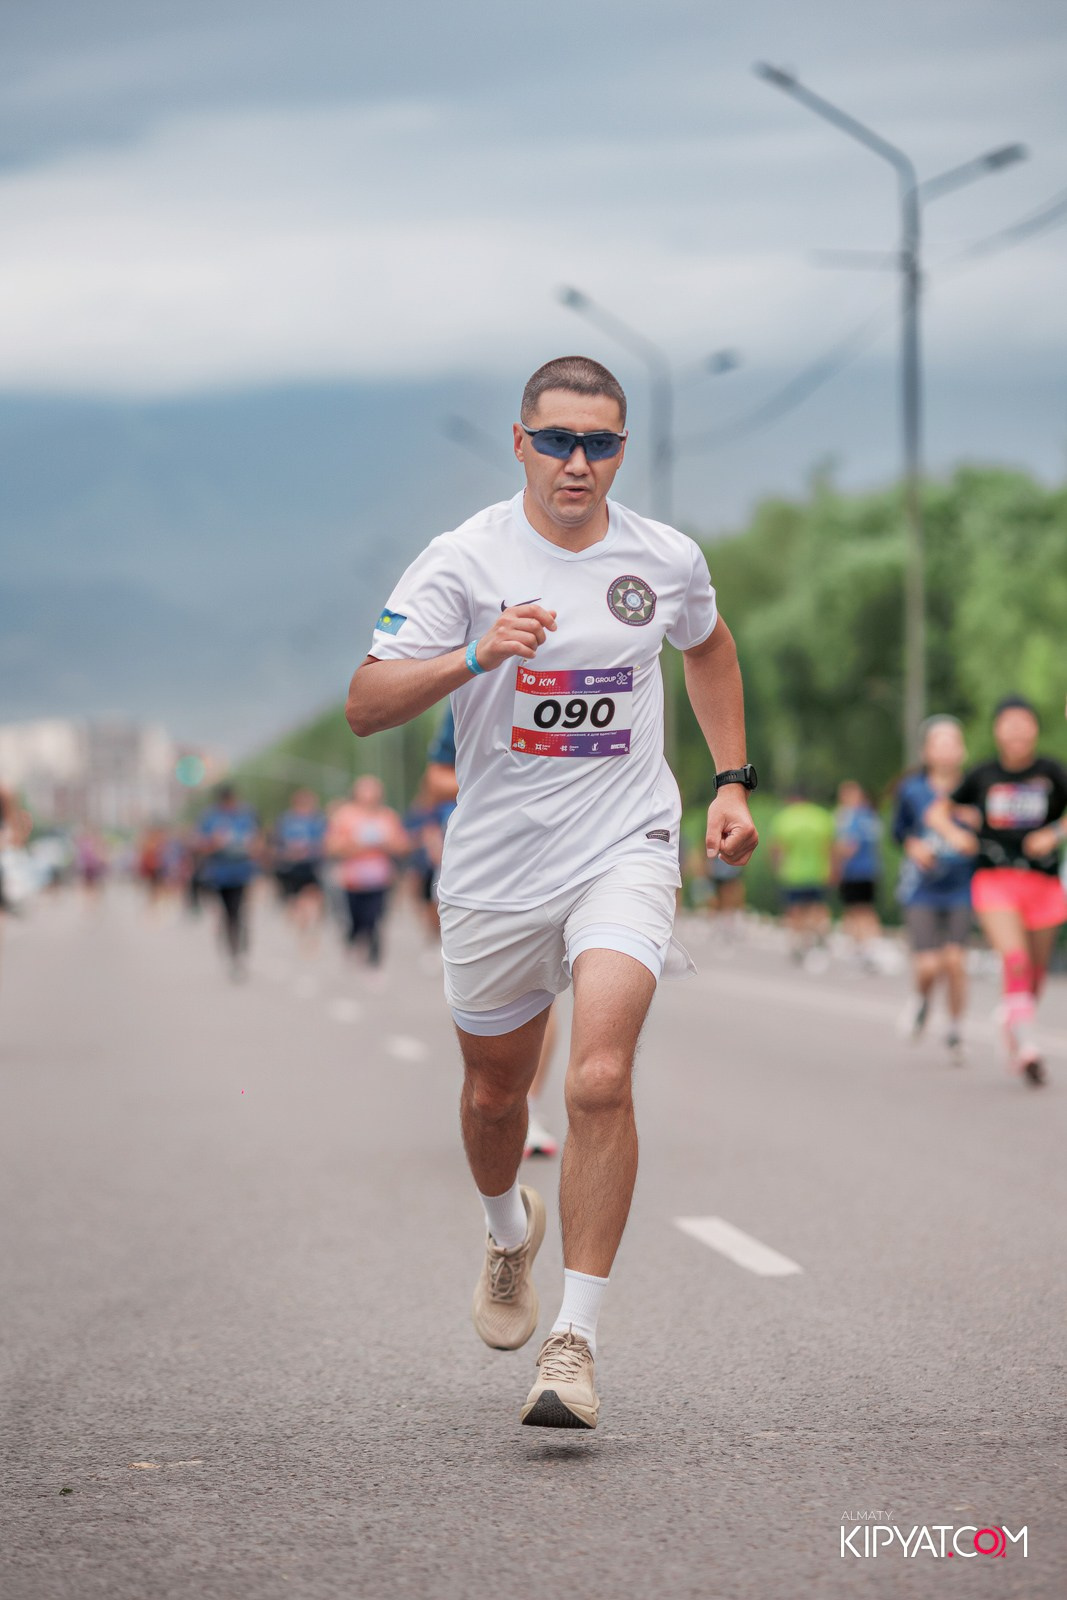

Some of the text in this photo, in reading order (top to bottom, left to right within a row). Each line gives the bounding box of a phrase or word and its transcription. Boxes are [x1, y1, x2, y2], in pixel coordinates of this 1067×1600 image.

[522, 673, 557, 687] 10 KM
[534, 697, 616, 729] 090
